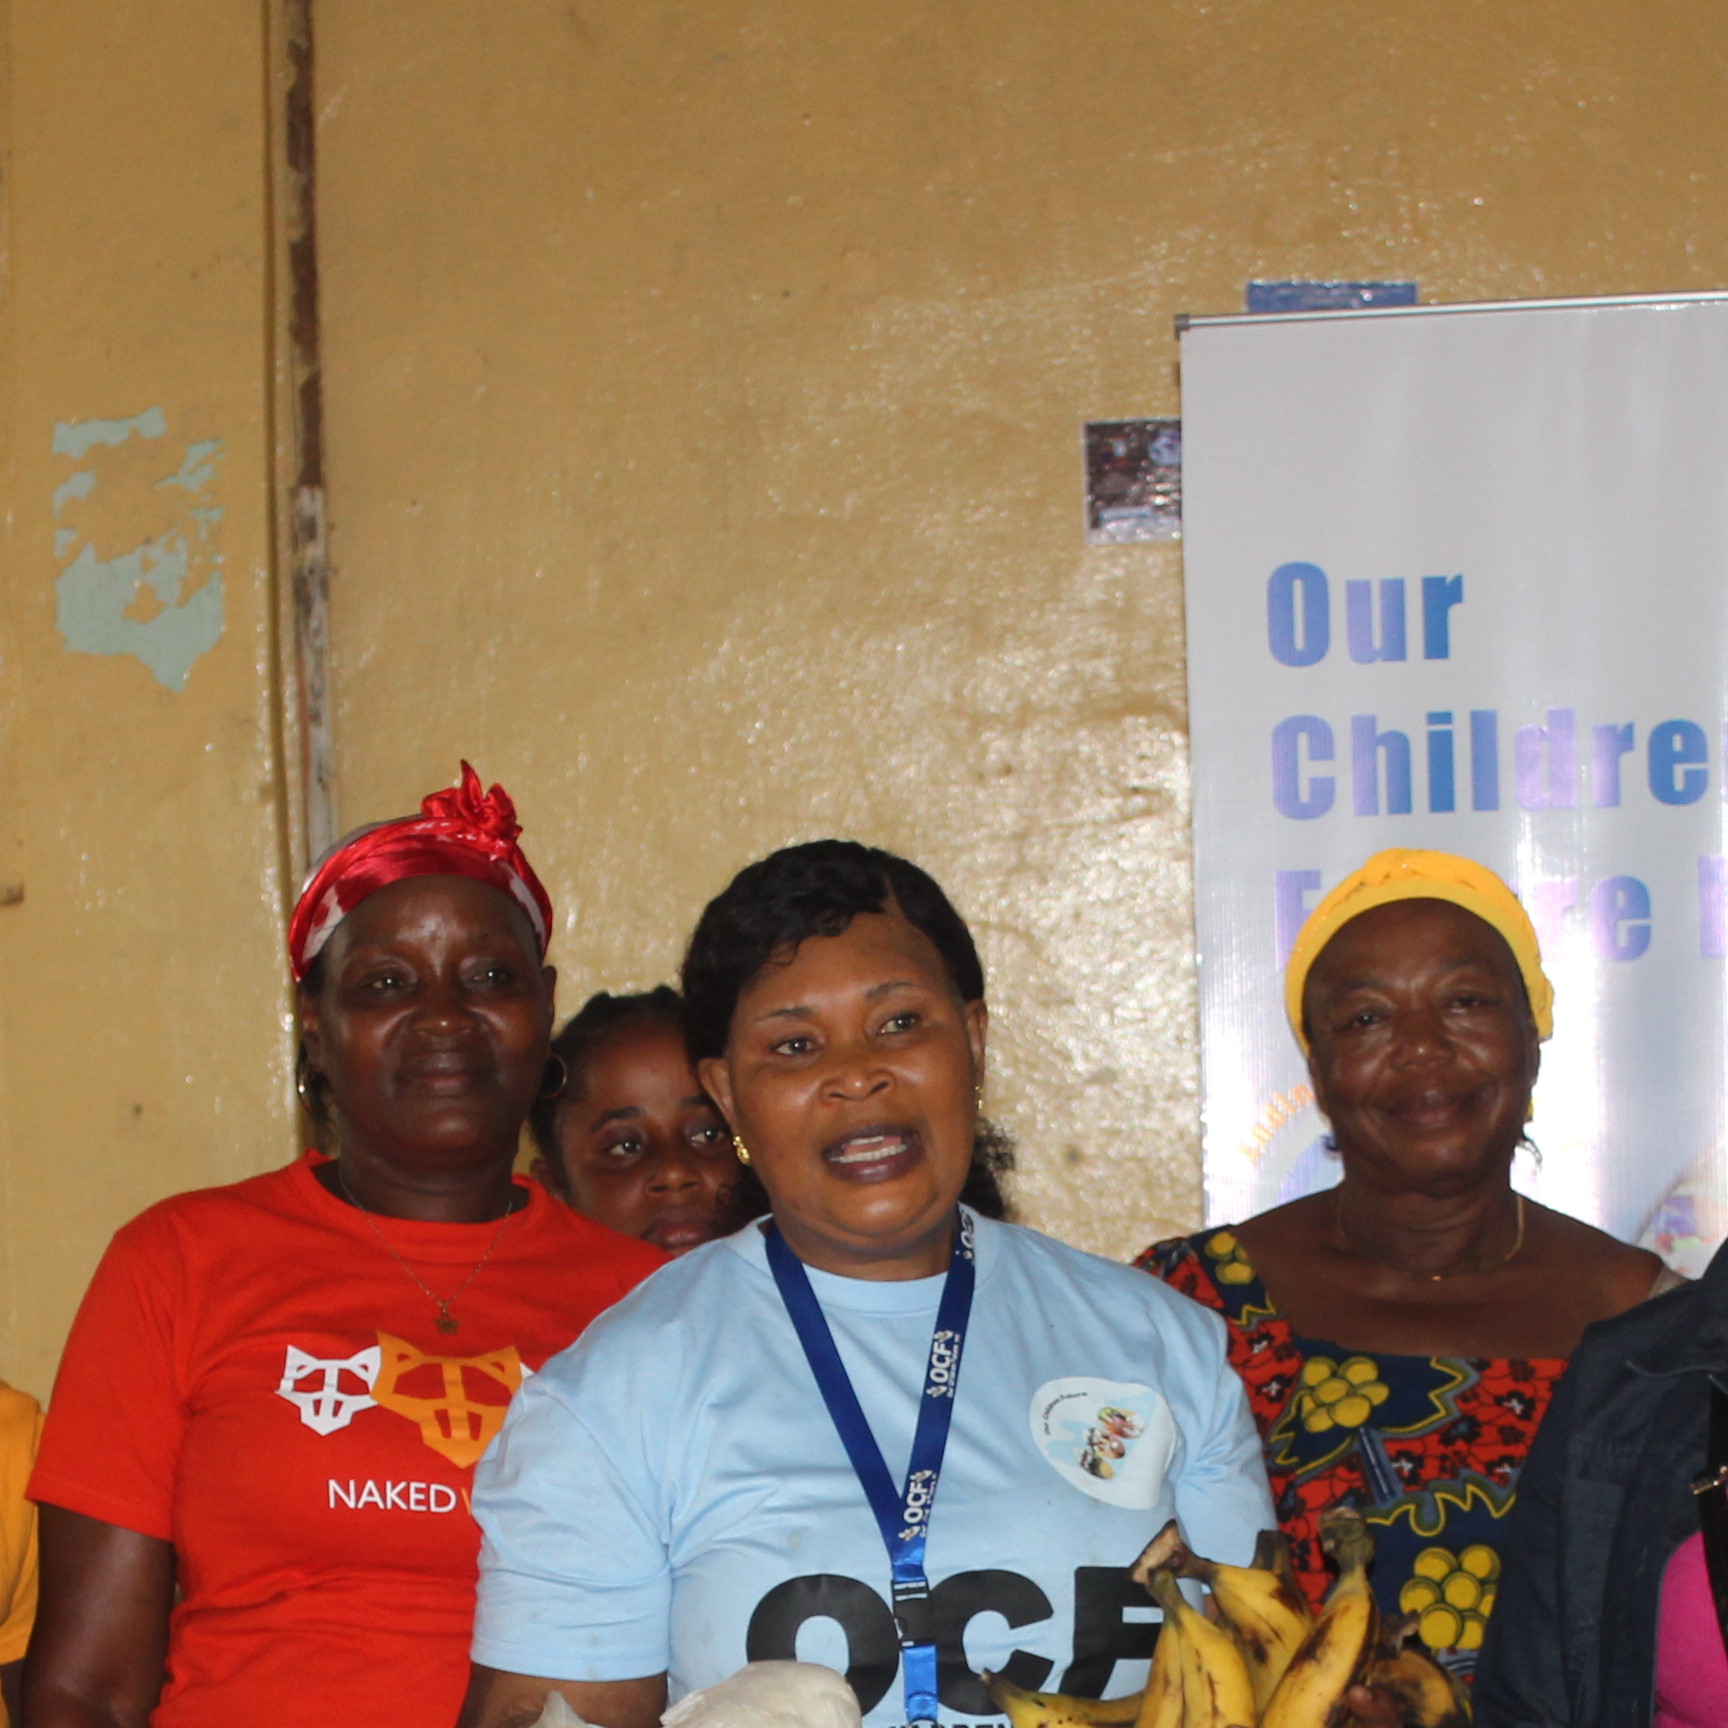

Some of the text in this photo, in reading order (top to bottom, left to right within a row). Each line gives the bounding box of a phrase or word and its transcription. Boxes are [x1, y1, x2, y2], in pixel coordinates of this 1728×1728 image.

[1266, 561, 1463, 668] Our
[929, 1341, 953, 1384] OCF
[328, 1479, 456, 1513] NAKED
[903, 1481, 929, 1525] OCF
